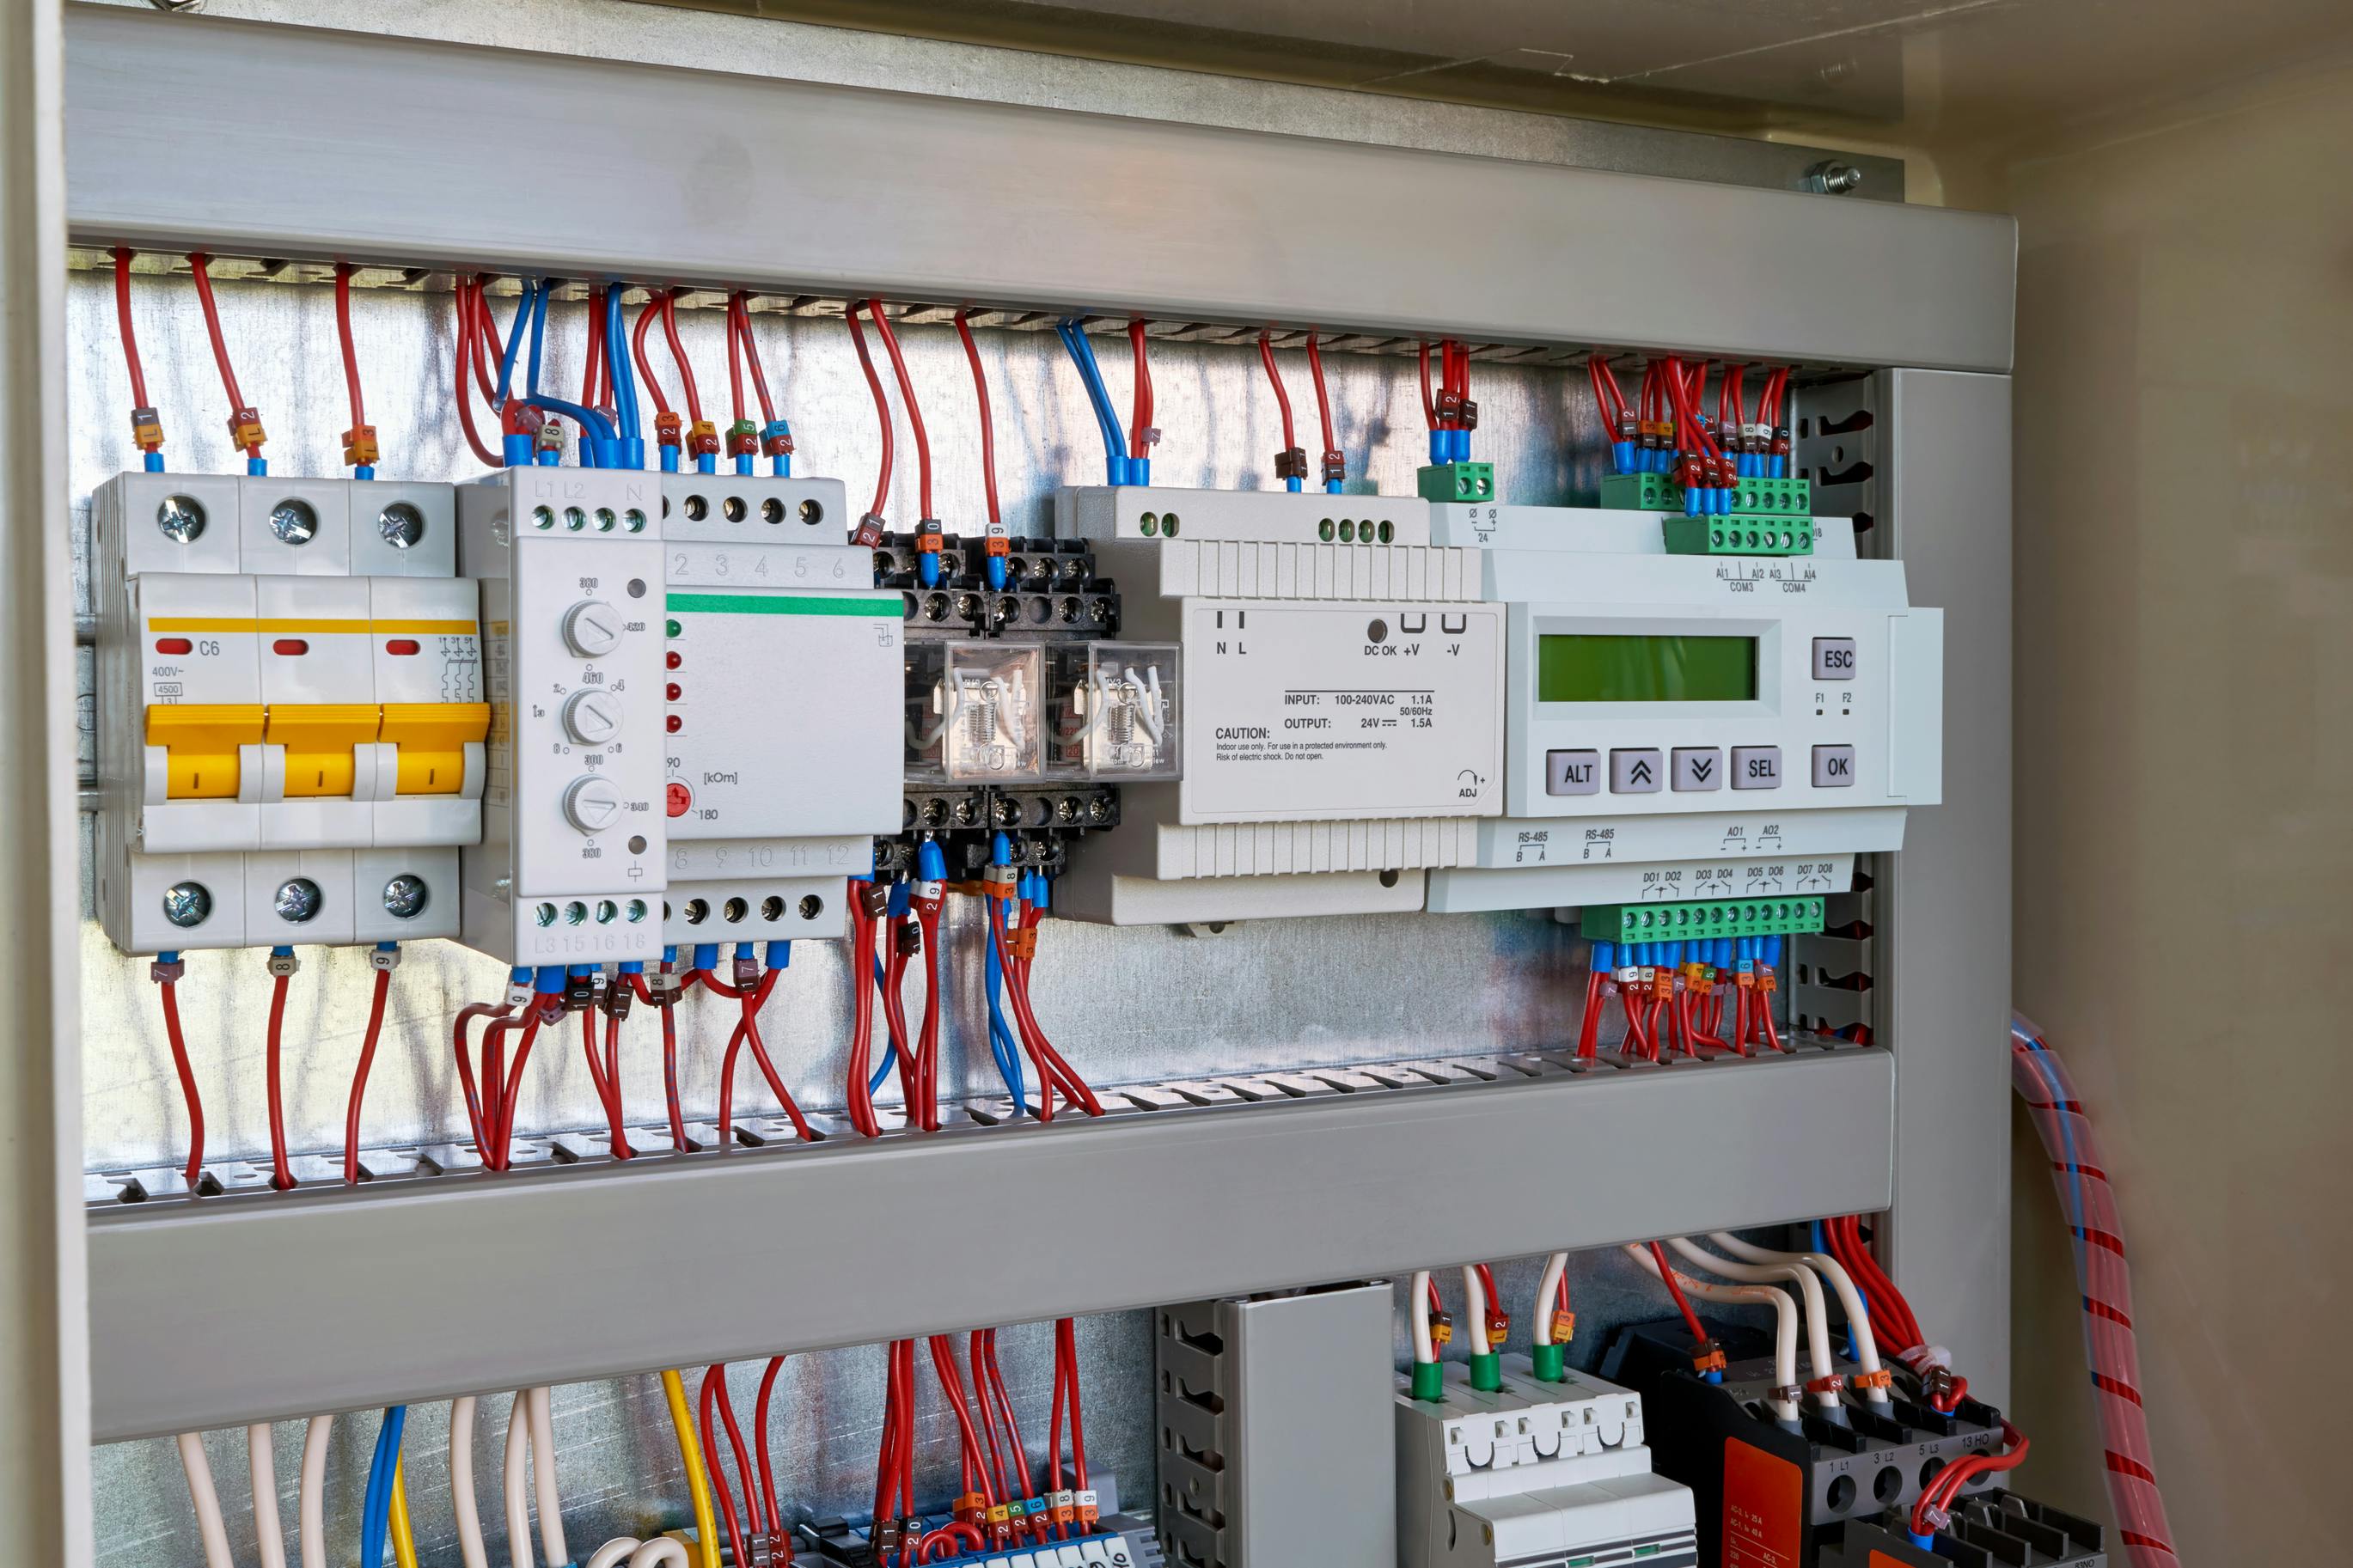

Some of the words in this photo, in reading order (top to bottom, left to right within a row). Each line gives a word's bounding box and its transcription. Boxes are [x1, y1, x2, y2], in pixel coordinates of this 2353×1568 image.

[534, 479, 555, 498] L1
[563, 481, 586, 499] L2
[626, 483, 643, 502] N
[1478, 532, 1488, 543] 24
[674, 556, 688, 576] 2
[714, 554, 730, 576] 3
[754, 555, 767, 576] 4
[793, 555, 808, 577] 5
[831, 557, 846, 578] 6
[1715, 568, 1728, 578] AI1
[1751, 568, 1764, 579] AI2
[1769, 569, 1782, 579] AI3
[1804, 570, 1817, 580] AI4
[1729, 582, 1754, 593] COM3
[1782, 583, 1806, 593] COM4
[199, 640, 220, 656] C6
[1216, 642, 1226, 655] N
[1238, 643, 1246, 655] L
[1364, 645, 1378, 656] DC
[1382, 645, 1397, 656] OK
[1403, 644, 1420, 656] +V
[1446, 644, 1460, 656] -V
[1824, 650, 1853, 668] ESC
[158, 685, 179, 693] 4500
[1285, 694, 1320, 705] INPUT:
[1335, 694, 1395, 705] 100-240VAC
[1411, 694, 1433, 705] 1.1A
[1815, 692, 1824, 704] F1
[1843, 692, 1852, 704] F2
[1399, 706, 1433, 716] 50/60Hz
[1284, 717, 1331, 729] OUTPUT:
[1410, 717, 1433, 728] 1.5A
[1215, 728, 1270, 739] CAUTION:
[1216, 742, 1237, 751] Indoor
[1250, 742, 1266, 752] only.
[1293, 741, 1299, 750] in
[1305, 741, 1334, 751] protected
[1373, 741, 1387, 750] only.
[667, 757, 681, 768] 90
[1216, 753, 1230, 761] Risk
[1262, 752, 1283, 760] shock.
[1306, 753, 1323, 762] open.
[1749, 759, 1775, 778] SEL
[1828, 758, 1849, 775] OK
[704, 772, 737, 785] [kOm]
[1564, 765, 1592, 784] ALT
[1458, 789, 1477, 798] ADJ
[700, 809, 718, 820] 180
[1519, 831, 1548, 843] RS-485
[1586, 828, 1615, 840] RS-485
[748, 845, 773, 868] 10
[791, 845, 809, 867] 11
[826, 843, 851, 866] 12
[1516, 851, 1522, 862] B
[1538, 850, 1545, 861] A
[1583, 848, 1589, 859] B
[1605, 847, 1611, 858] A
[1962, 1436, 1972, 1449] 13
[1919, 1444, 1925, 1455] 5
[1929, 1443, 1940, 1455] L3
[1873, 1452, 1879, 1464] 3
[1885, 1452, 1894, 1462] L2
[1830, 1462, 1834, 1472] 1
[1840, 1461, 1849, 1471] L1
